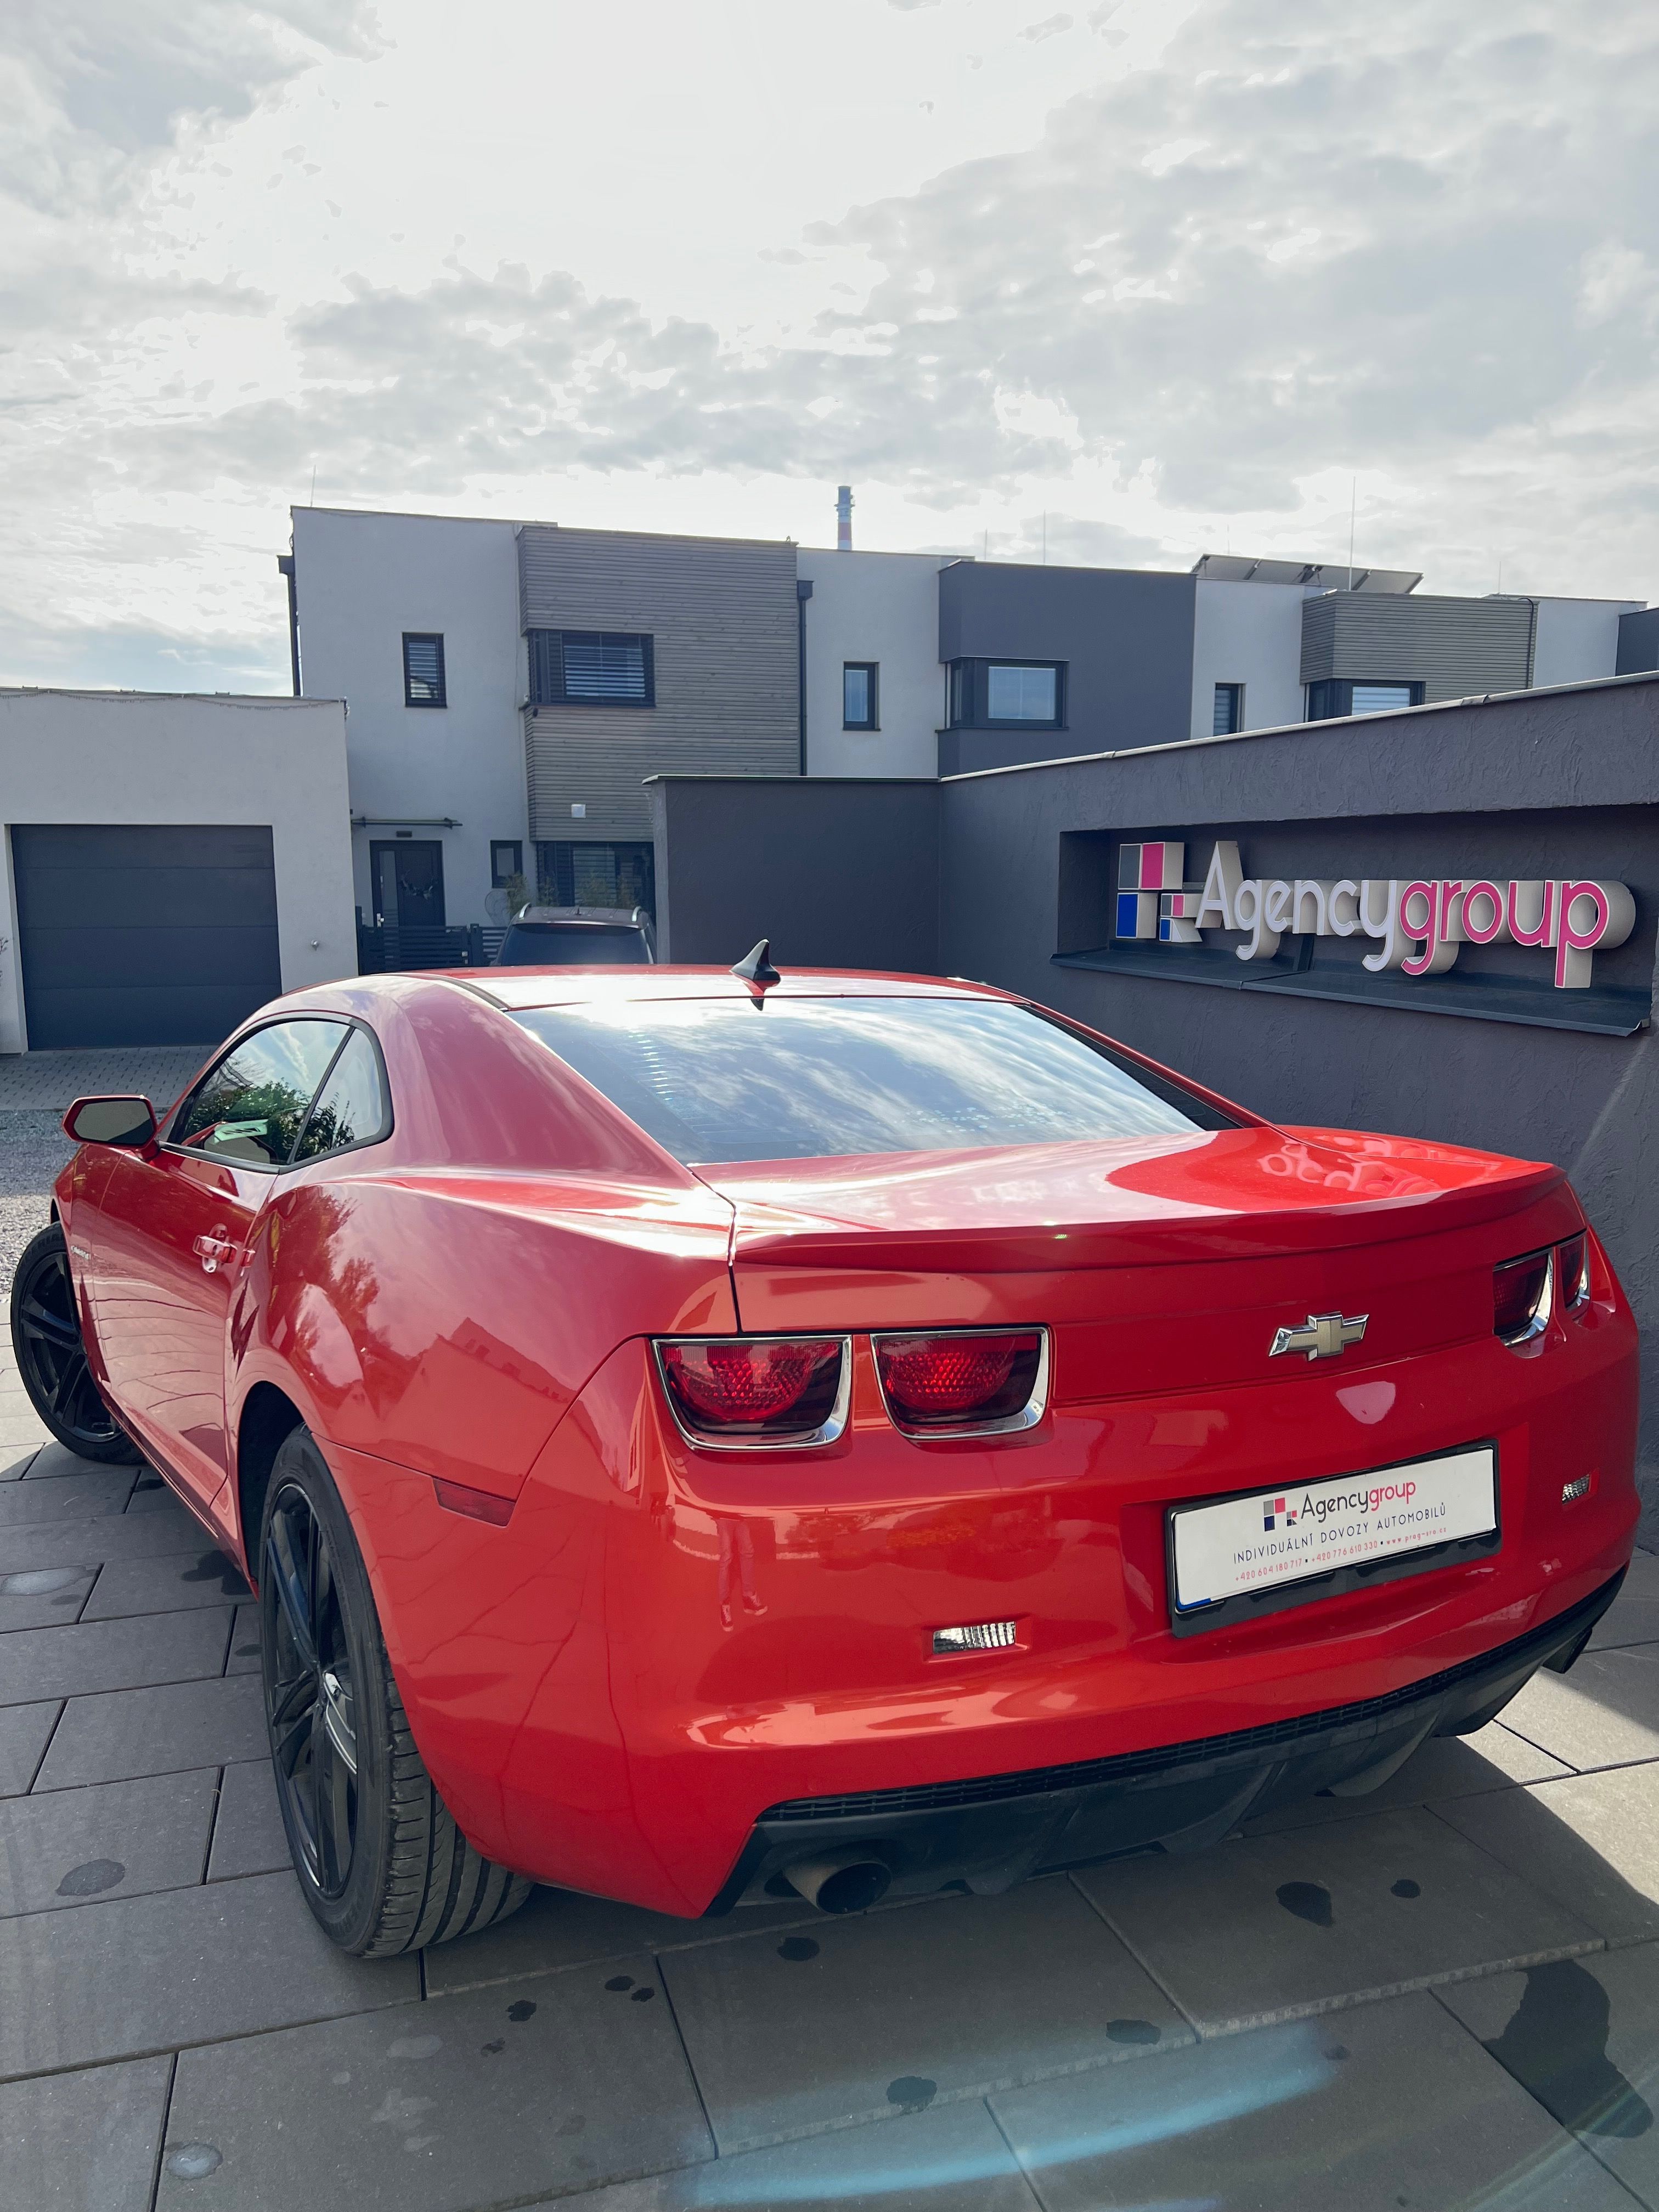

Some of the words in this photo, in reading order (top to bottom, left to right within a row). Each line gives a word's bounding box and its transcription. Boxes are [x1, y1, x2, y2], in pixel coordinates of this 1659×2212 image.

[1195, 840, 1611, 988] Agencygroup
[1301, 1481, 1416, 1523] Agencygroup
[1234, 1533, 1313, 1564] INDIVIDUÁLNÍ
[1321, 1522, 1369, 1543] DOVOZY
[1377, 1502, 1446, 1531] AUTOMOBILŮ
[1235, 1570, 1255, 1582] +420
[1258, 1564, 1274, 1577] 604
[1276, 1562, 1288, 1573] 180
[1291, 1558, 1302, 1568] 717
[1312, 1552, 1331, 1563] +420
[1333, 1547, 1347, 1559] 776
[1350, 1543, 1362, 1554] 610
[1364, 1540, 1378, 1551] 330
